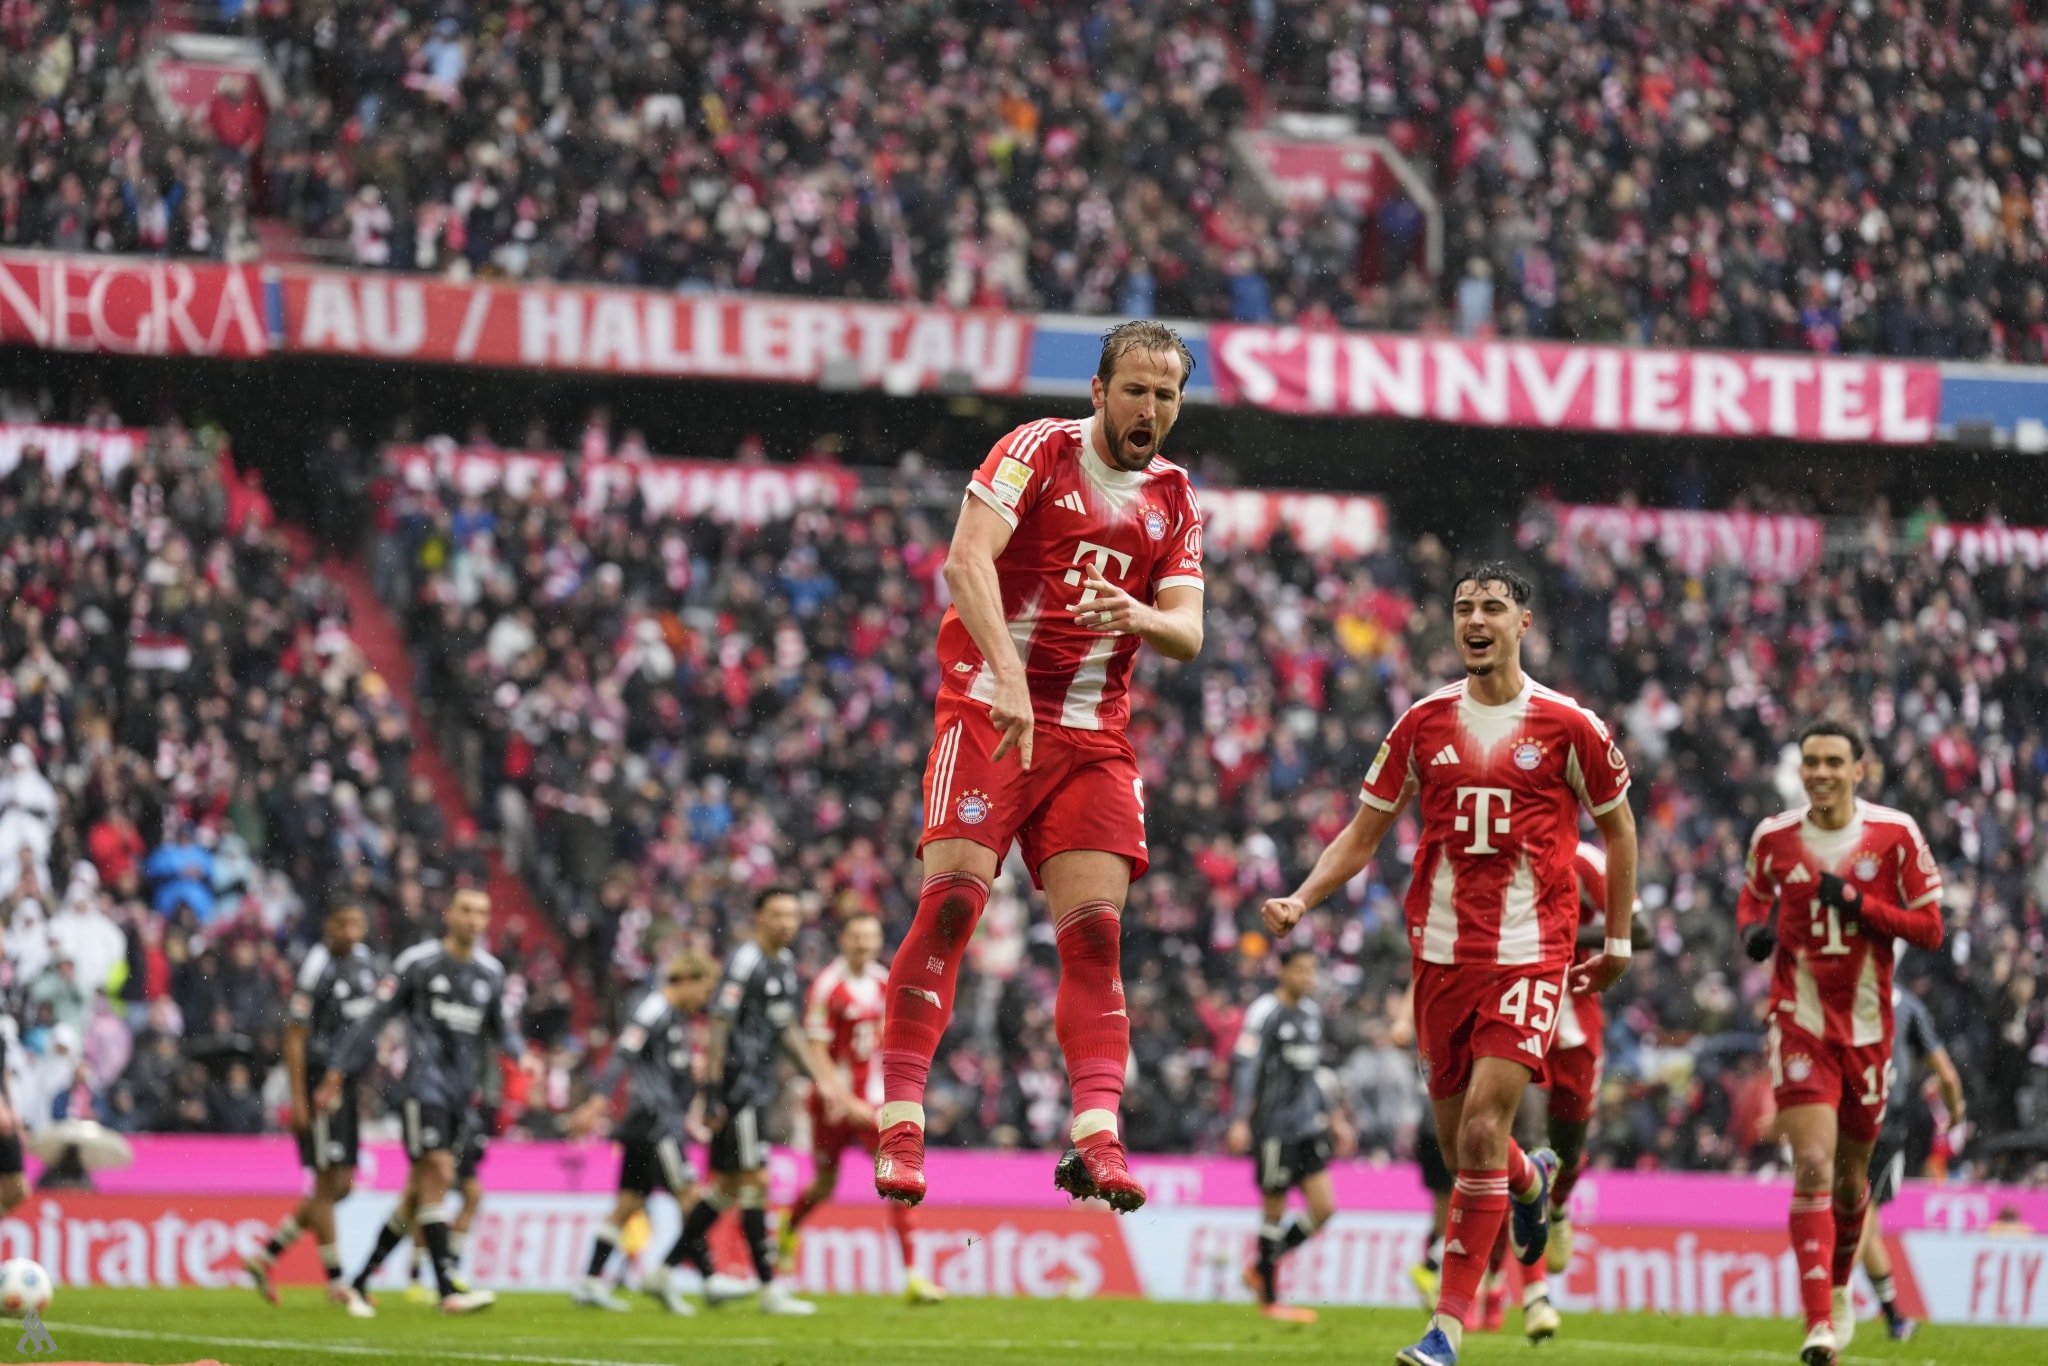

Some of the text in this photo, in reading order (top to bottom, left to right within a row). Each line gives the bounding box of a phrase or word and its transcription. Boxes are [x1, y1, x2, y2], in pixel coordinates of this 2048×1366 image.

[303, 279, 1028, 392] AU / HALLERTAU
[1220, 328, 1930, 440] S'INNVIERTEL
[1454, 787, 1511, 855] T
[1500, 977, 1558, 1033] 45
[775, 1218, 1104, 1300] mirates
[1969, 1250, 2044, 1318] FLY
